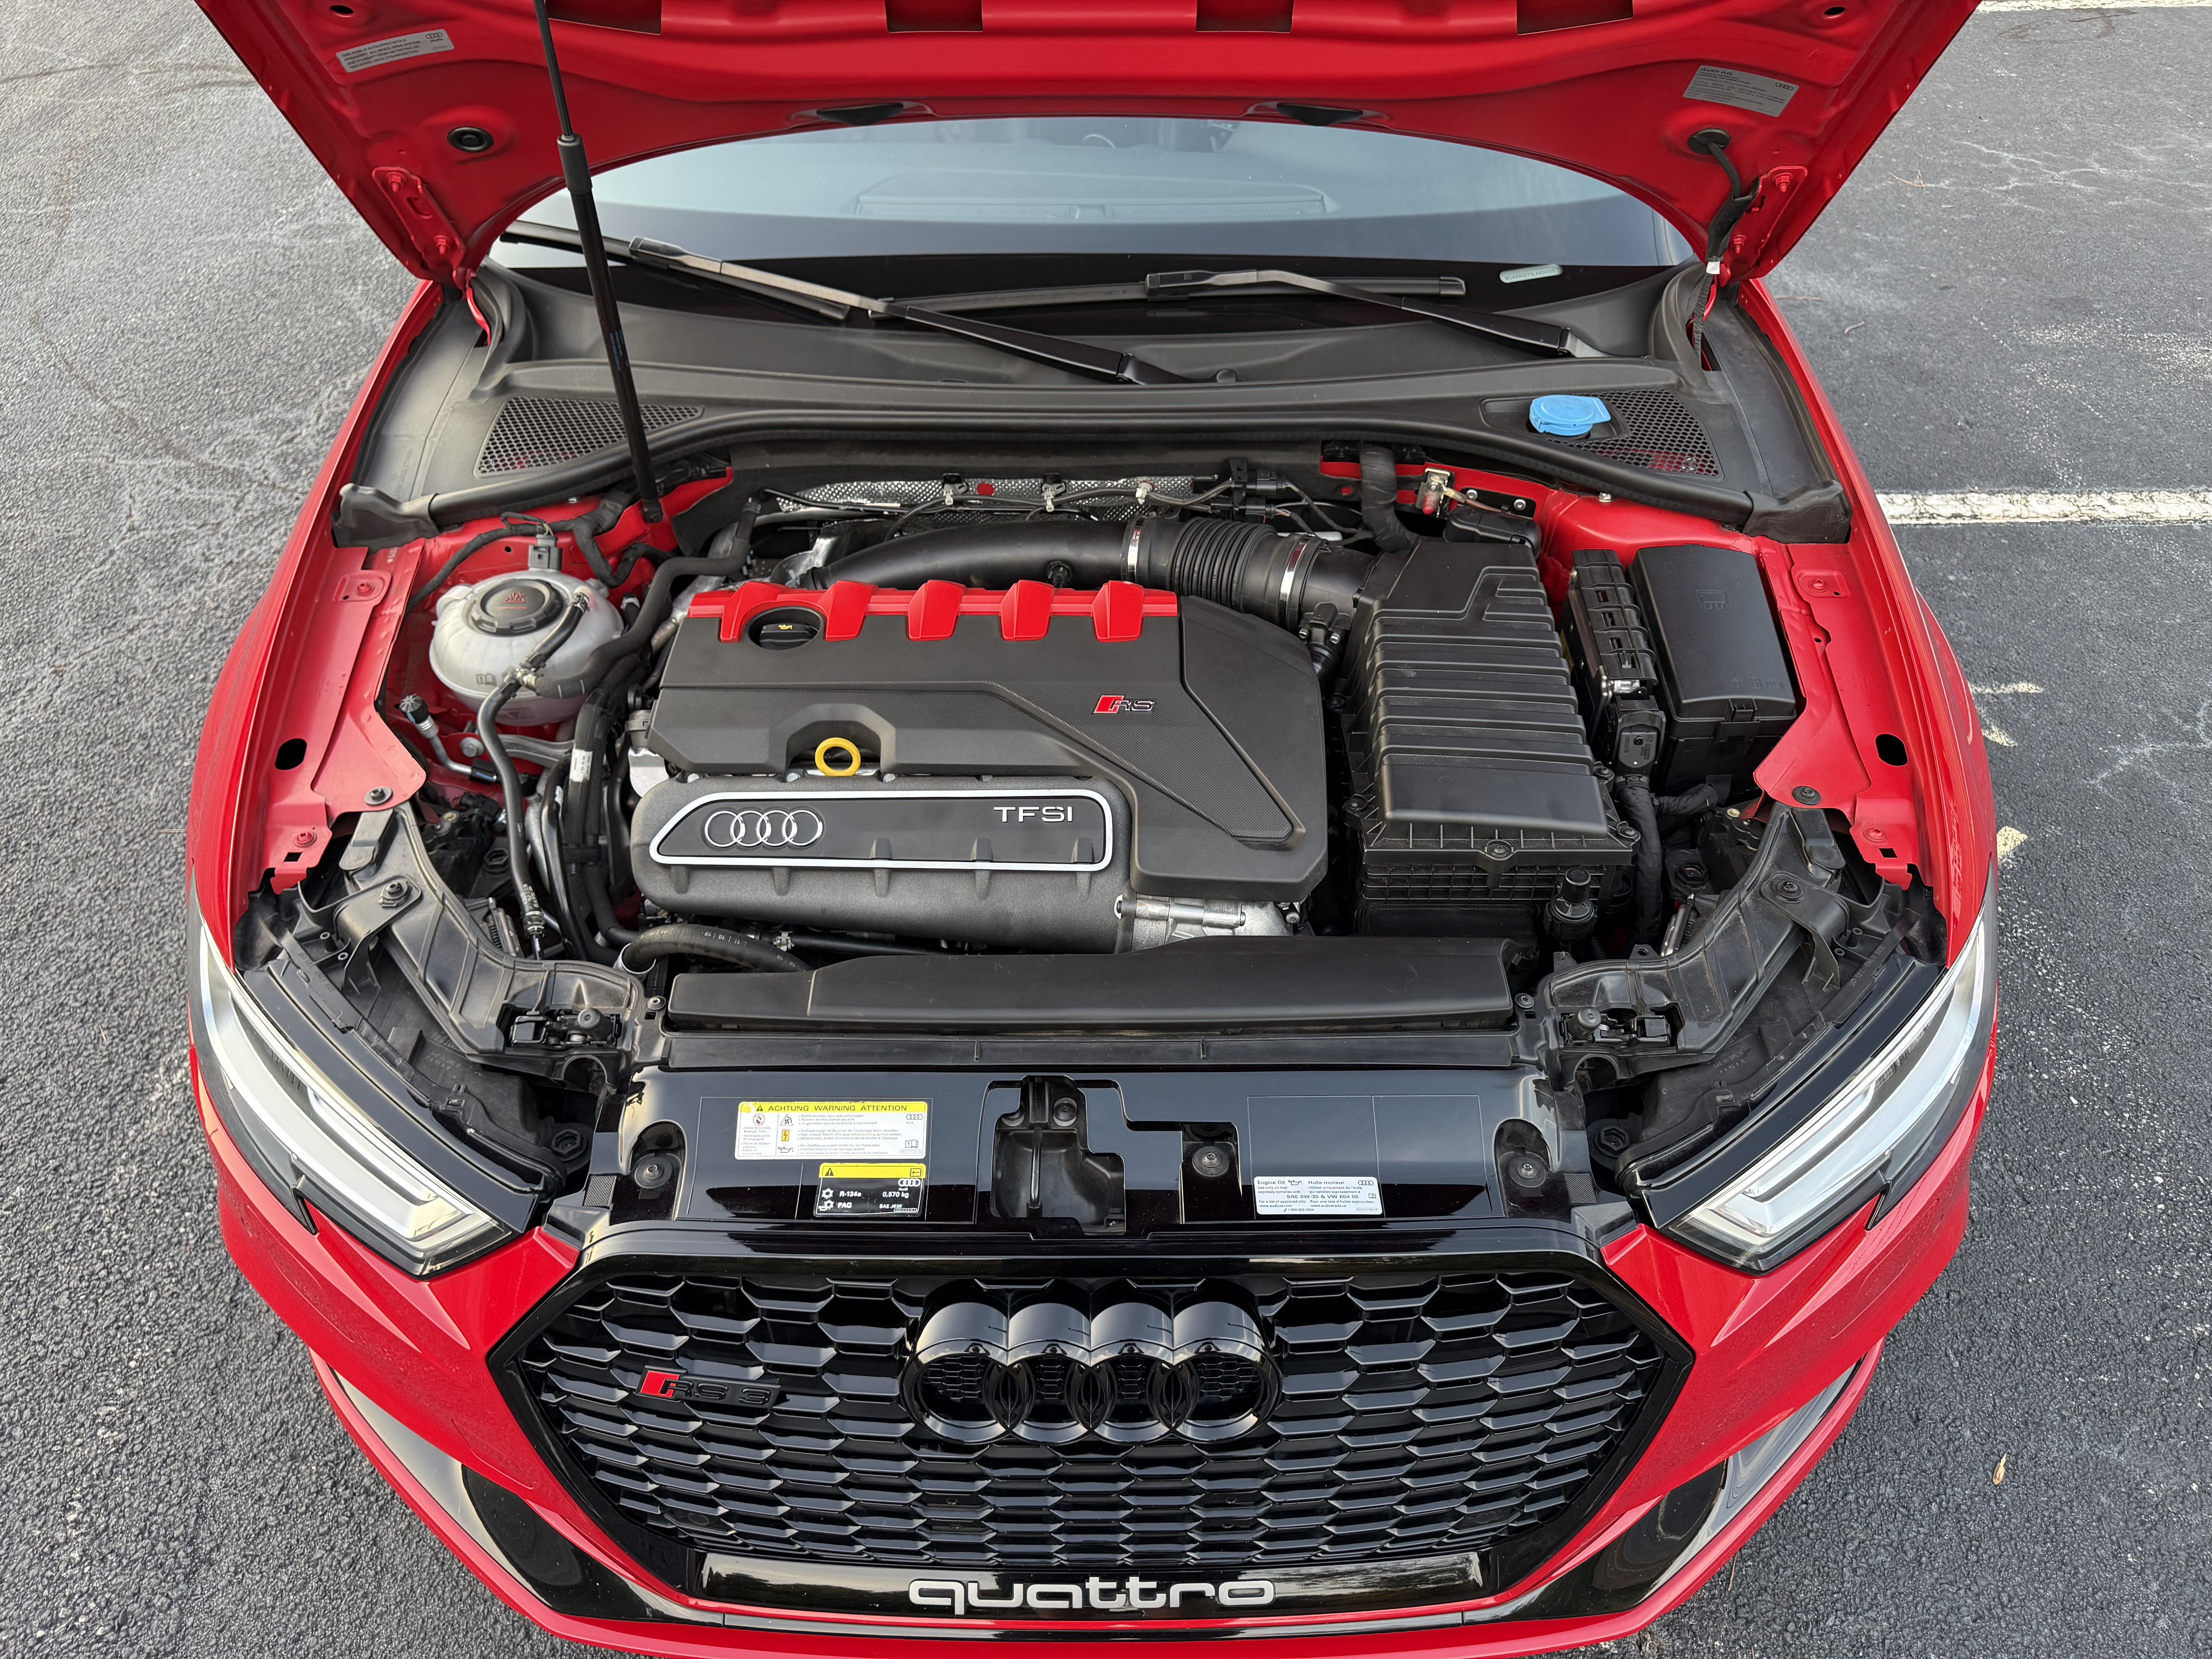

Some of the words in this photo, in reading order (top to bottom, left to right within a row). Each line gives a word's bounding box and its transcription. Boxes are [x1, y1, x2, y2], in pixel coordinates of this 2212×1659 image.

[1109, 699, 1155, 711] RS
[994, 806, 1073, 823] TFSI
[659, 1378, 729, 1400] RS
[738, 1388, 771, 1405] 3
[909, 1576, 1276, 1616] quattro
